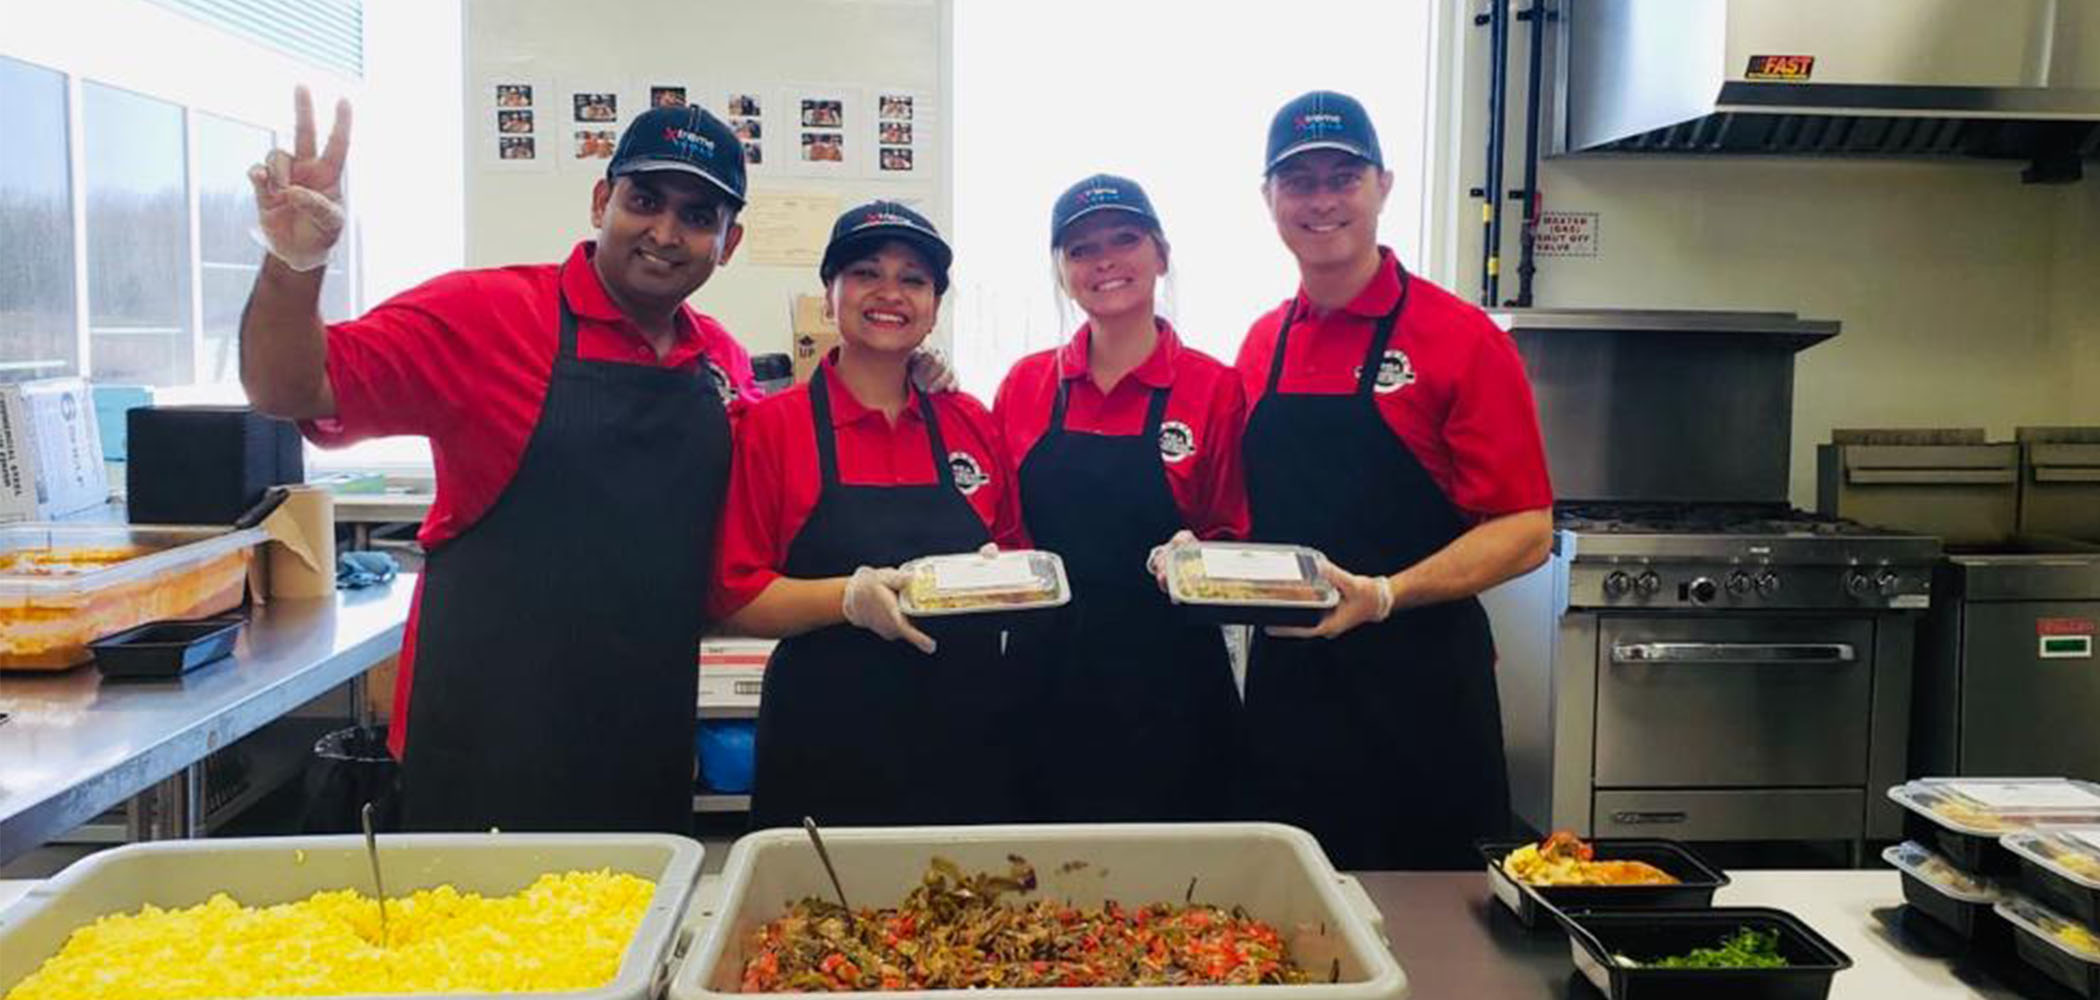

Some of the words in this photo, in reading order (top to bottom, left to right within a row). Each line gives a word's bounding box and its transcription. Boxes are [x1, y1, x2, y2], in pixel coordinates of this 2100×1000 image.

[1764, 57, 1809, 74] FAST
[1550, 225, 1581, 233] (GAS)
[1537, 234, 1566, 243] SHUT
[1570, 234, 1588, 243] OFF
[800, 347, 815, 359] UP
